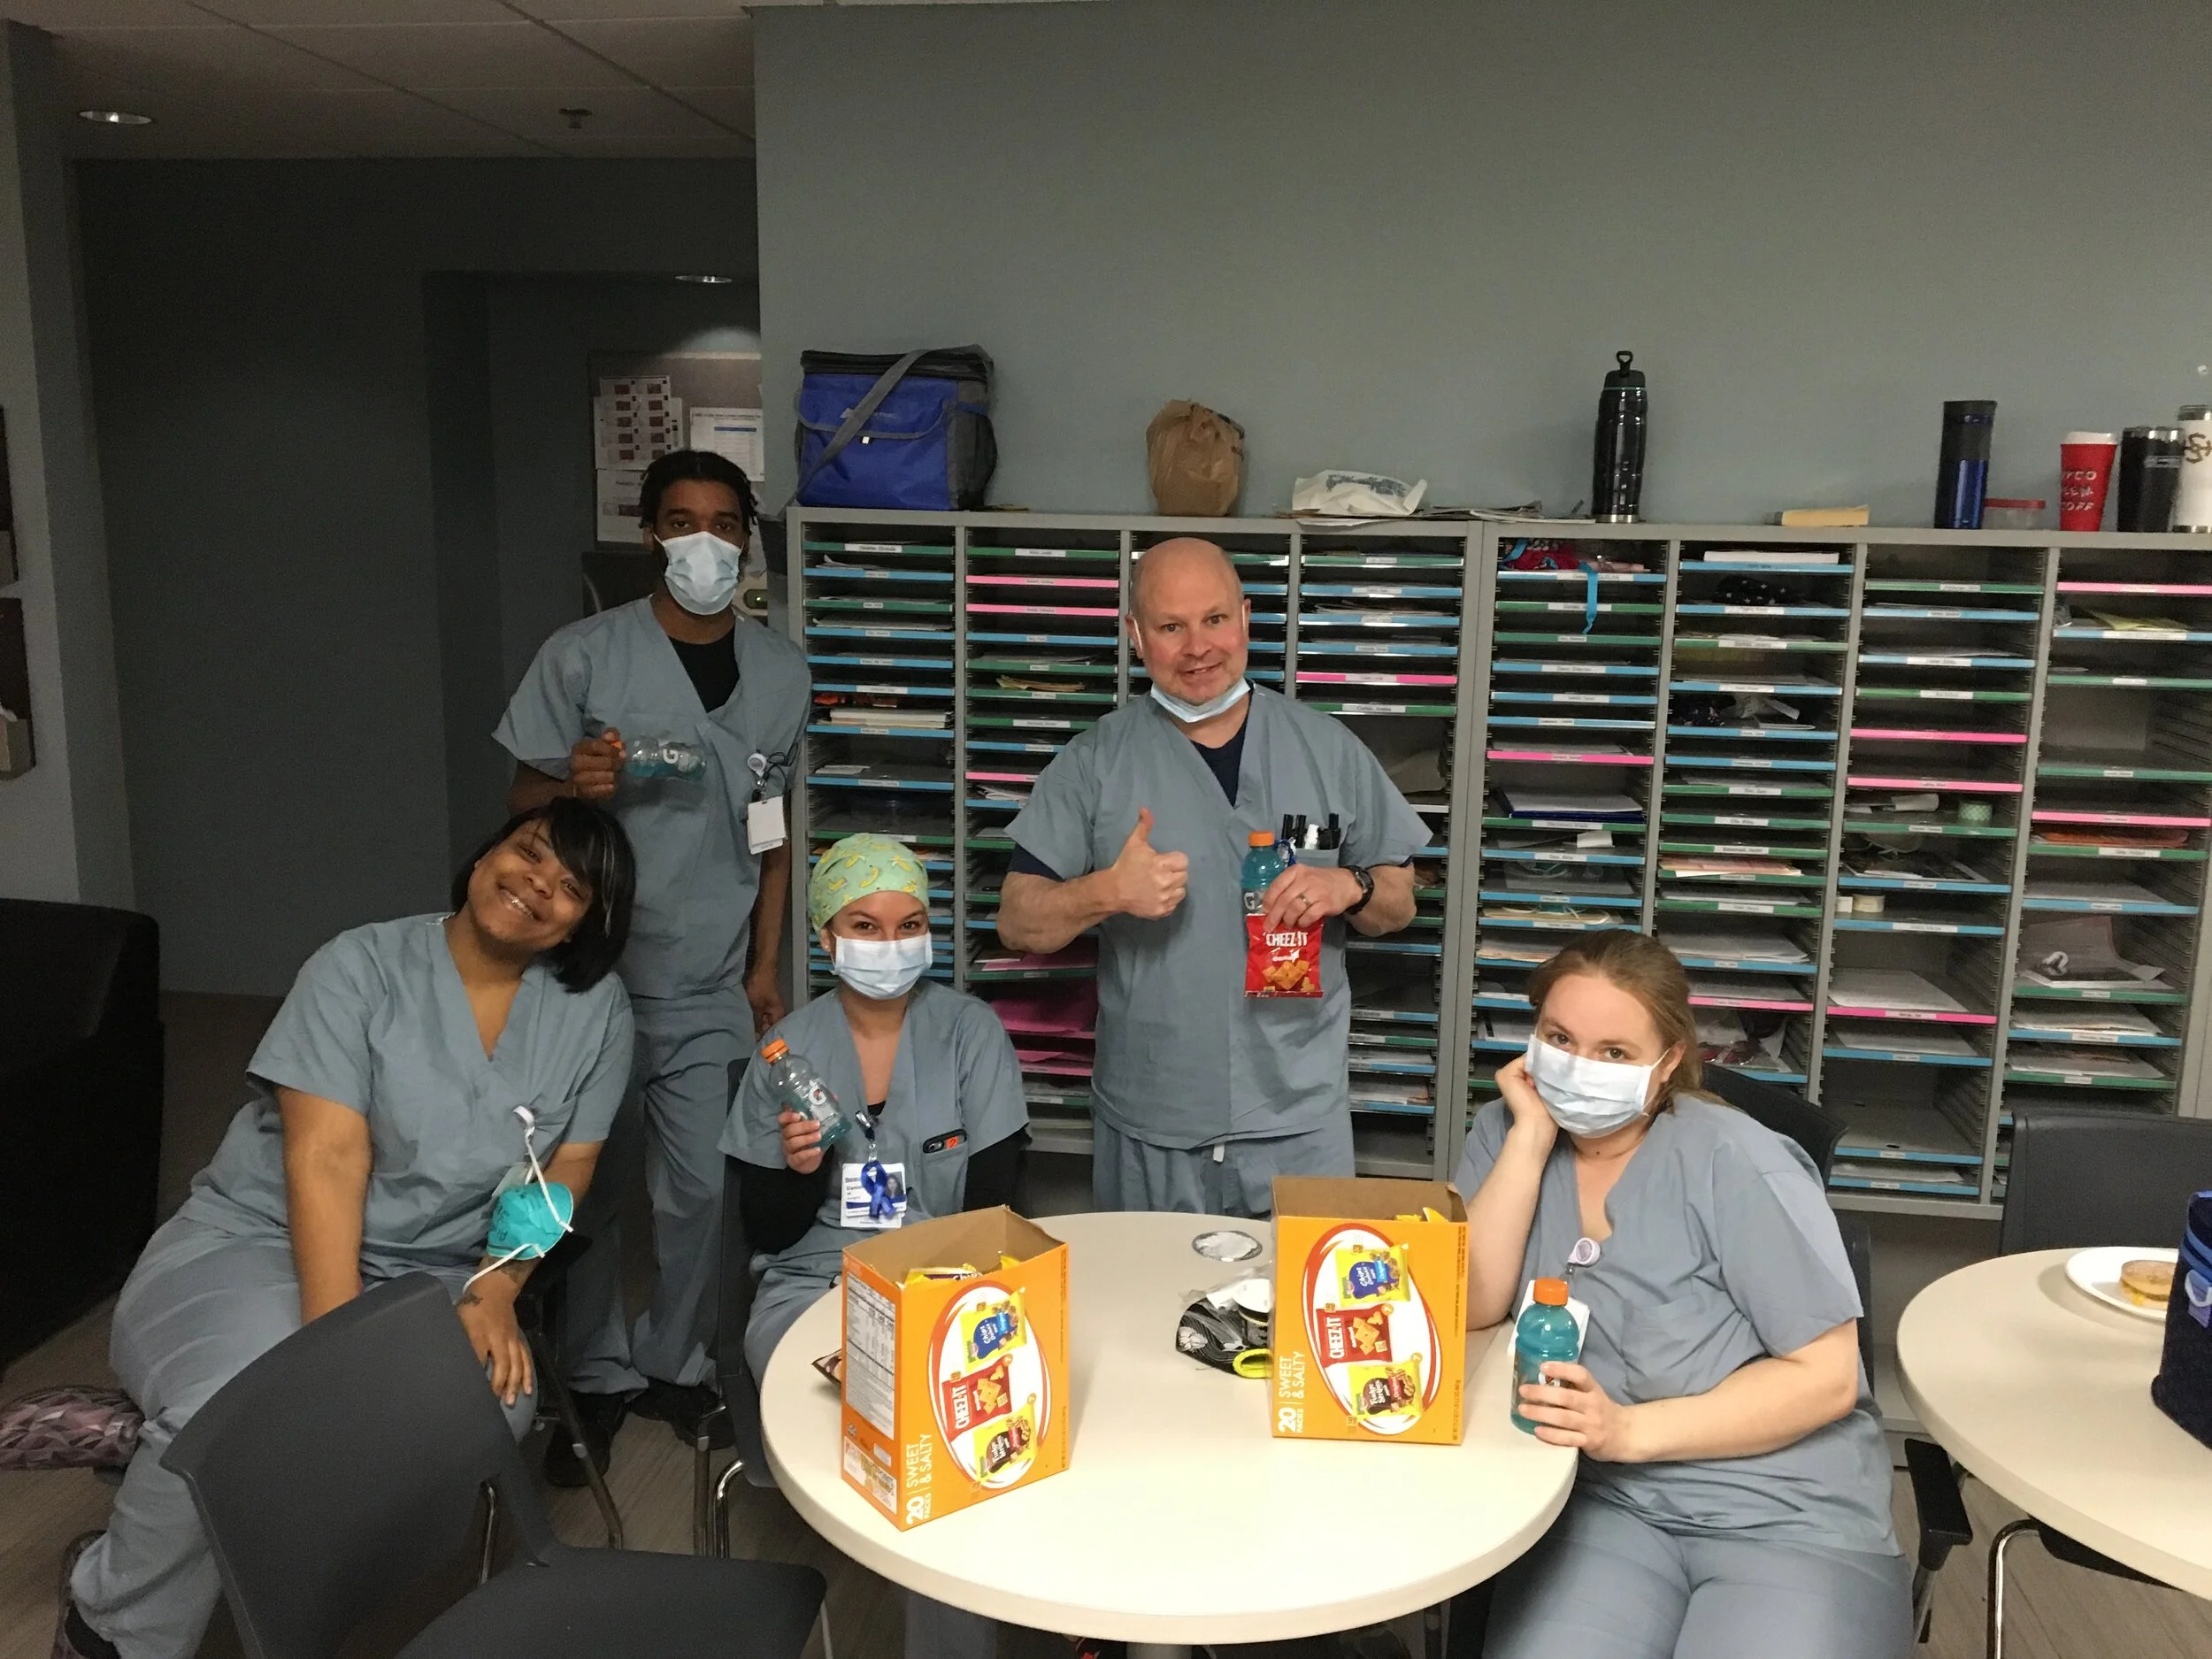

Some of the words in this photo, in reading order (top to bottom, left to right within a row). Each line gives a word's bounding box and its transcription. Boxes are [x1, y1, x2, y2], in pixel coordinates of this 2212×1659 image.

[1279, 1356, 1292, 1399] SWEET
[1292, 1351, 1305, 1388] SALTY
[1292, 1390, 1304, 1399] &
[1278, 1407, 1296, 1432] 20
[906, 1443, 919, 1488] SWEET
[919, 1433, 933, 1472] SALTY
[919, 1472, 933, 1484] &
[906, 1495, 926, 1525] 20
